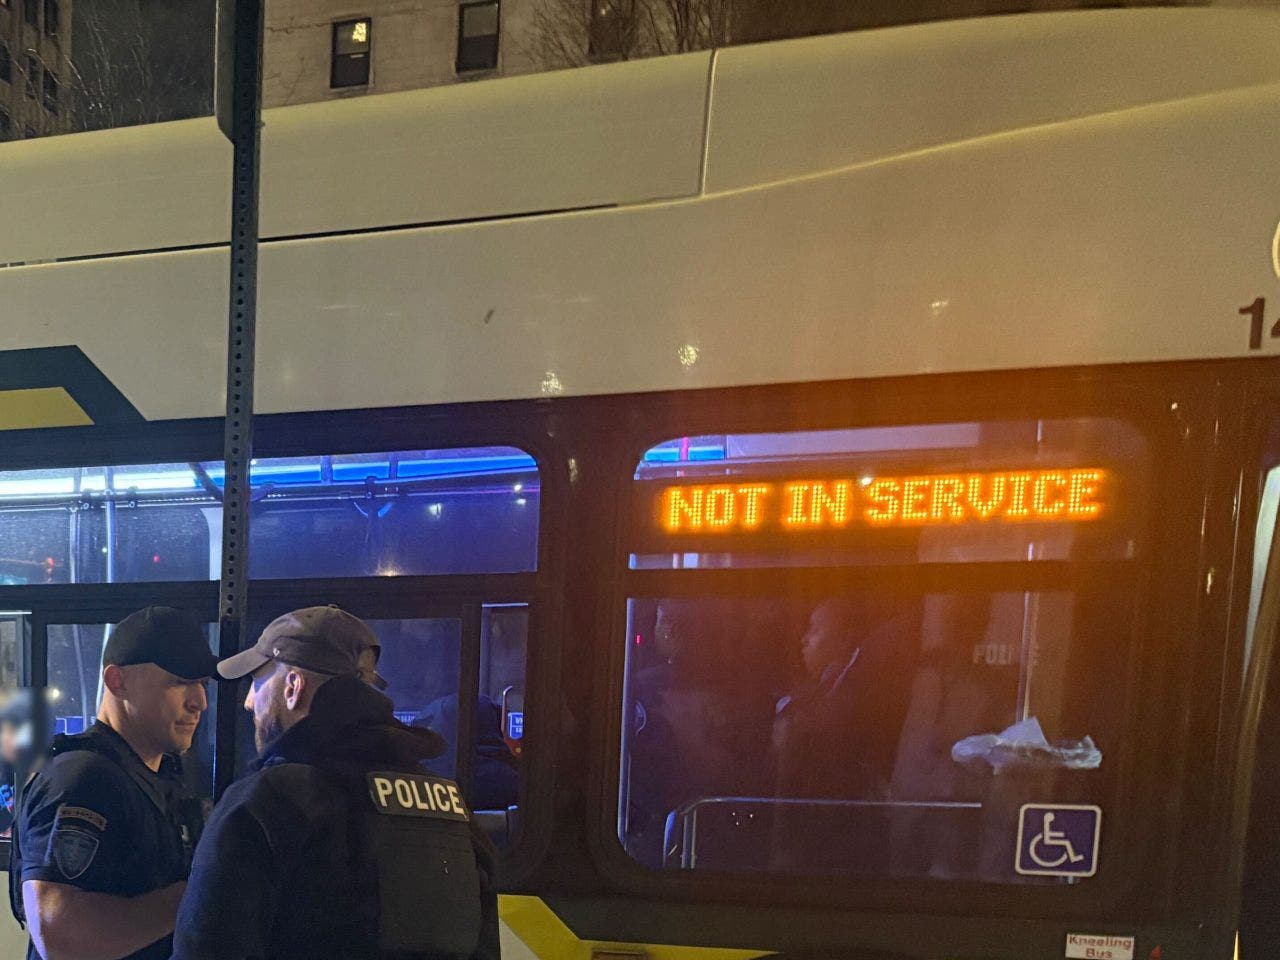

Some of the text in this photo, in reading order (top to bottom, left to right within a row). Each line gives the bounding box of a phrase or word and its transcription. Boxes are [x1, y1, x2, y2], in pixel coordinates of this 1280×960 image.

[666, 472, 1100, 528] NOT IN SERVICE
[374, 777, 467, 815] POLICE
[1069, 936, 1132, 951] Kneeling
[1085, 948, 1113, 959] Bus
